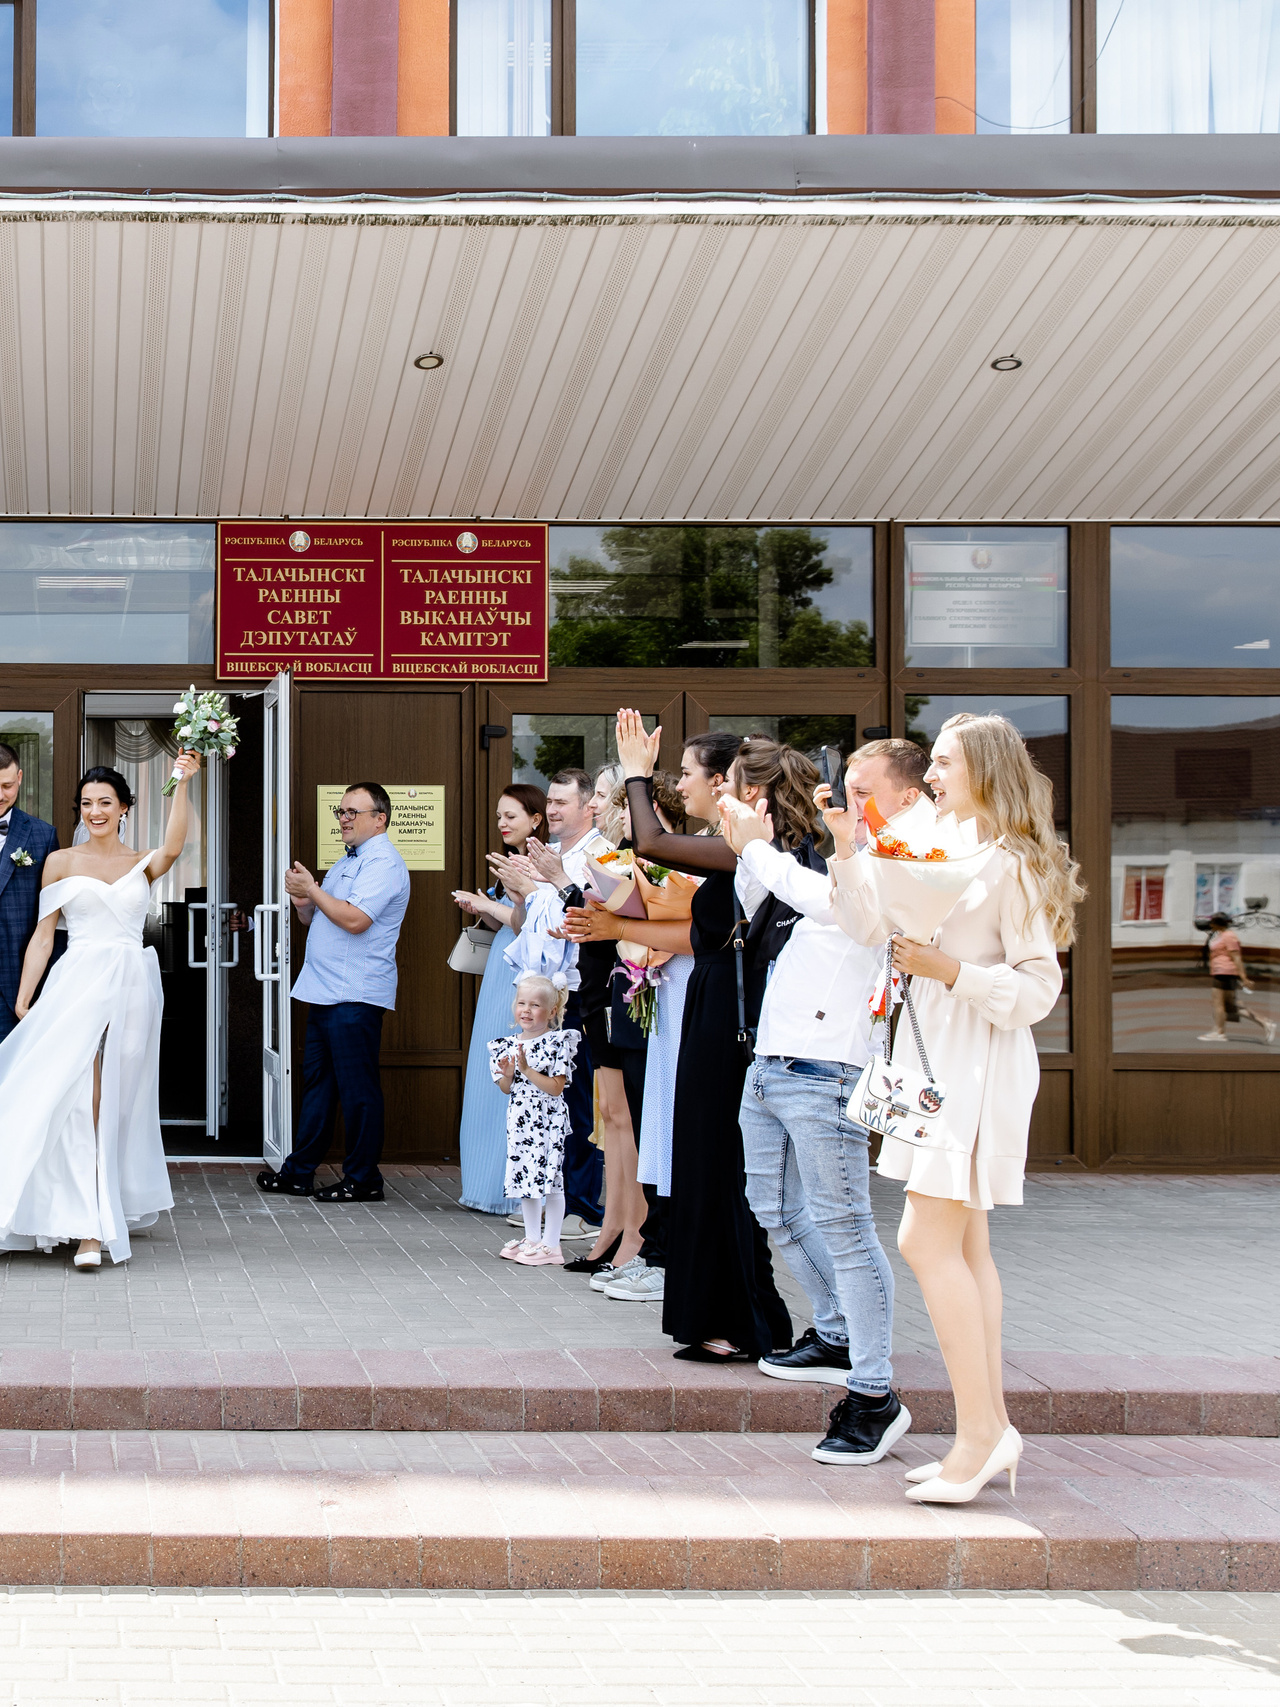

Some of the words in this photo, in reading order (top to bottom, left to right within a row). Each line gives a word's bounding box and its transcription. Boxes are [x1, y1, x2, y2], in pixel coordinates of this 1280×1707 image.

[224, 537, 286, 545] РЭСПУБЛІКА
[313, 537, 364, 546] БЕЛАРУСЬ
[392, 539, 453, 547] РЭСПУБЛІКА
[481, 539, 532, 548] БЕЛАРУСЬ
[232, 567, 366, 583] ТАЛАЧЫНСКІ
[399, 569, 532, 584] ТАЛАЧЫНСКІ
[257, 588, 341, 604] РАЕННЫ
[424, 590, 508, 605] РАЕННЫ
[267, 609, 332, 625] САВЕТ
[399, 607, 532, 625] ВЫКАНАЎЧЫ
[239, 628, 358, 648] ДЭПУТАТАЎ
[420, 631, 512, 647] КАМІТЭТ
[226, 660, 302, 674] ВІЦЕБСКАЙ
[305, 662, 373, 675] ВОБЛАСЦІ
[392, 661, 468, 675] ВІЦЕБСКАЙ
[471, 663, 538, 676] ВОБЛАСЦІ
